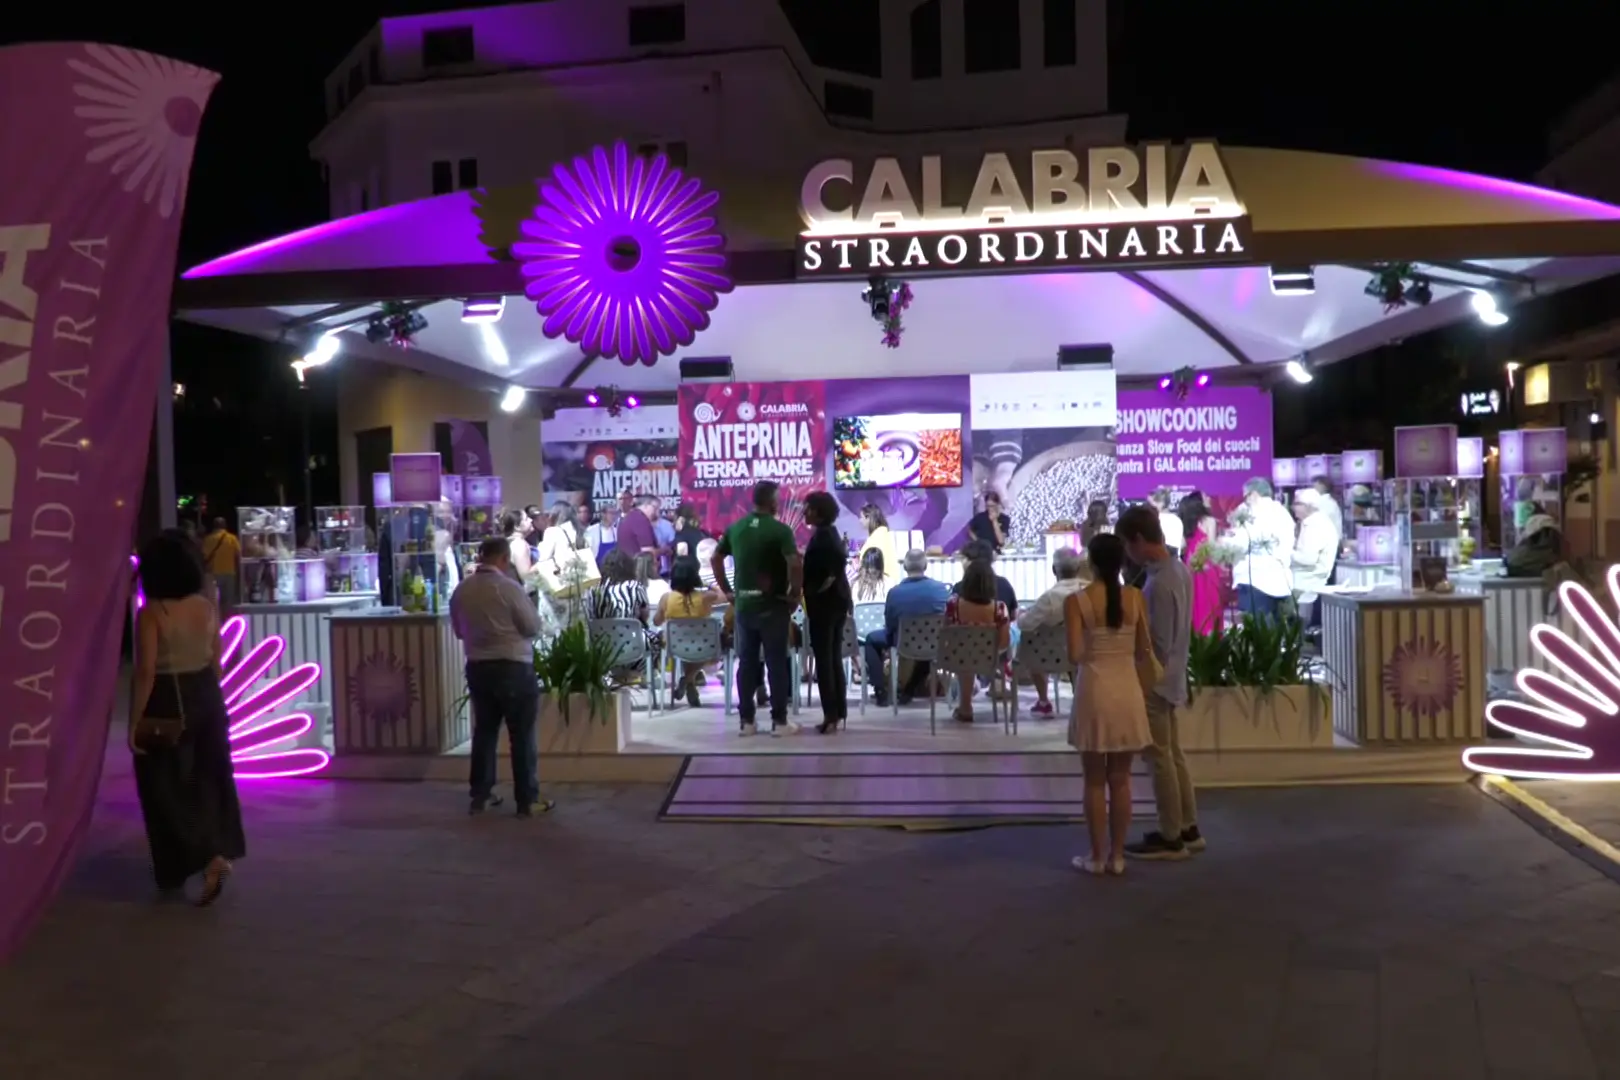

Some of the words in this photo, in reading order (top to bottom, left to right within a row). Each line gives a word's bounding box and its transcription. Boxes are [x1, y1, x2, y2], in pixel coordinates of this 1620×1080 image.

[799, 141, 1245, 233] CALABRIA
[803, 222, 1244, 270] STRAORDINARIA
[760, 403, 808, 414] CALABRIA
[1116, 406, 1237, 434] SHOWCOOKING
[693, 421, 813, 460] ANTEPRIMA
[1147, 439, 1173, 455] Slow
[1177, 438, 1201, 454] Food
[1204, 438, 1221, 453] dei
[1225, 437, 1260, 451] cuochi
[693, 461, 749, 479] TERRA
[753, 458, 814, 477] MADRE
[1154, 457, 1176, 472] GAL
[1178, 456, 1204, 472] della
[1207, 455, 1251, 471] Calabria
[592, 469, 681, 498] ANTEPRIMA
[693, 479, 718, 488] 19-21
[720, 477, 754, 487] GIUGNO
[3, 235, 108, 845] STRAORDINARIA
